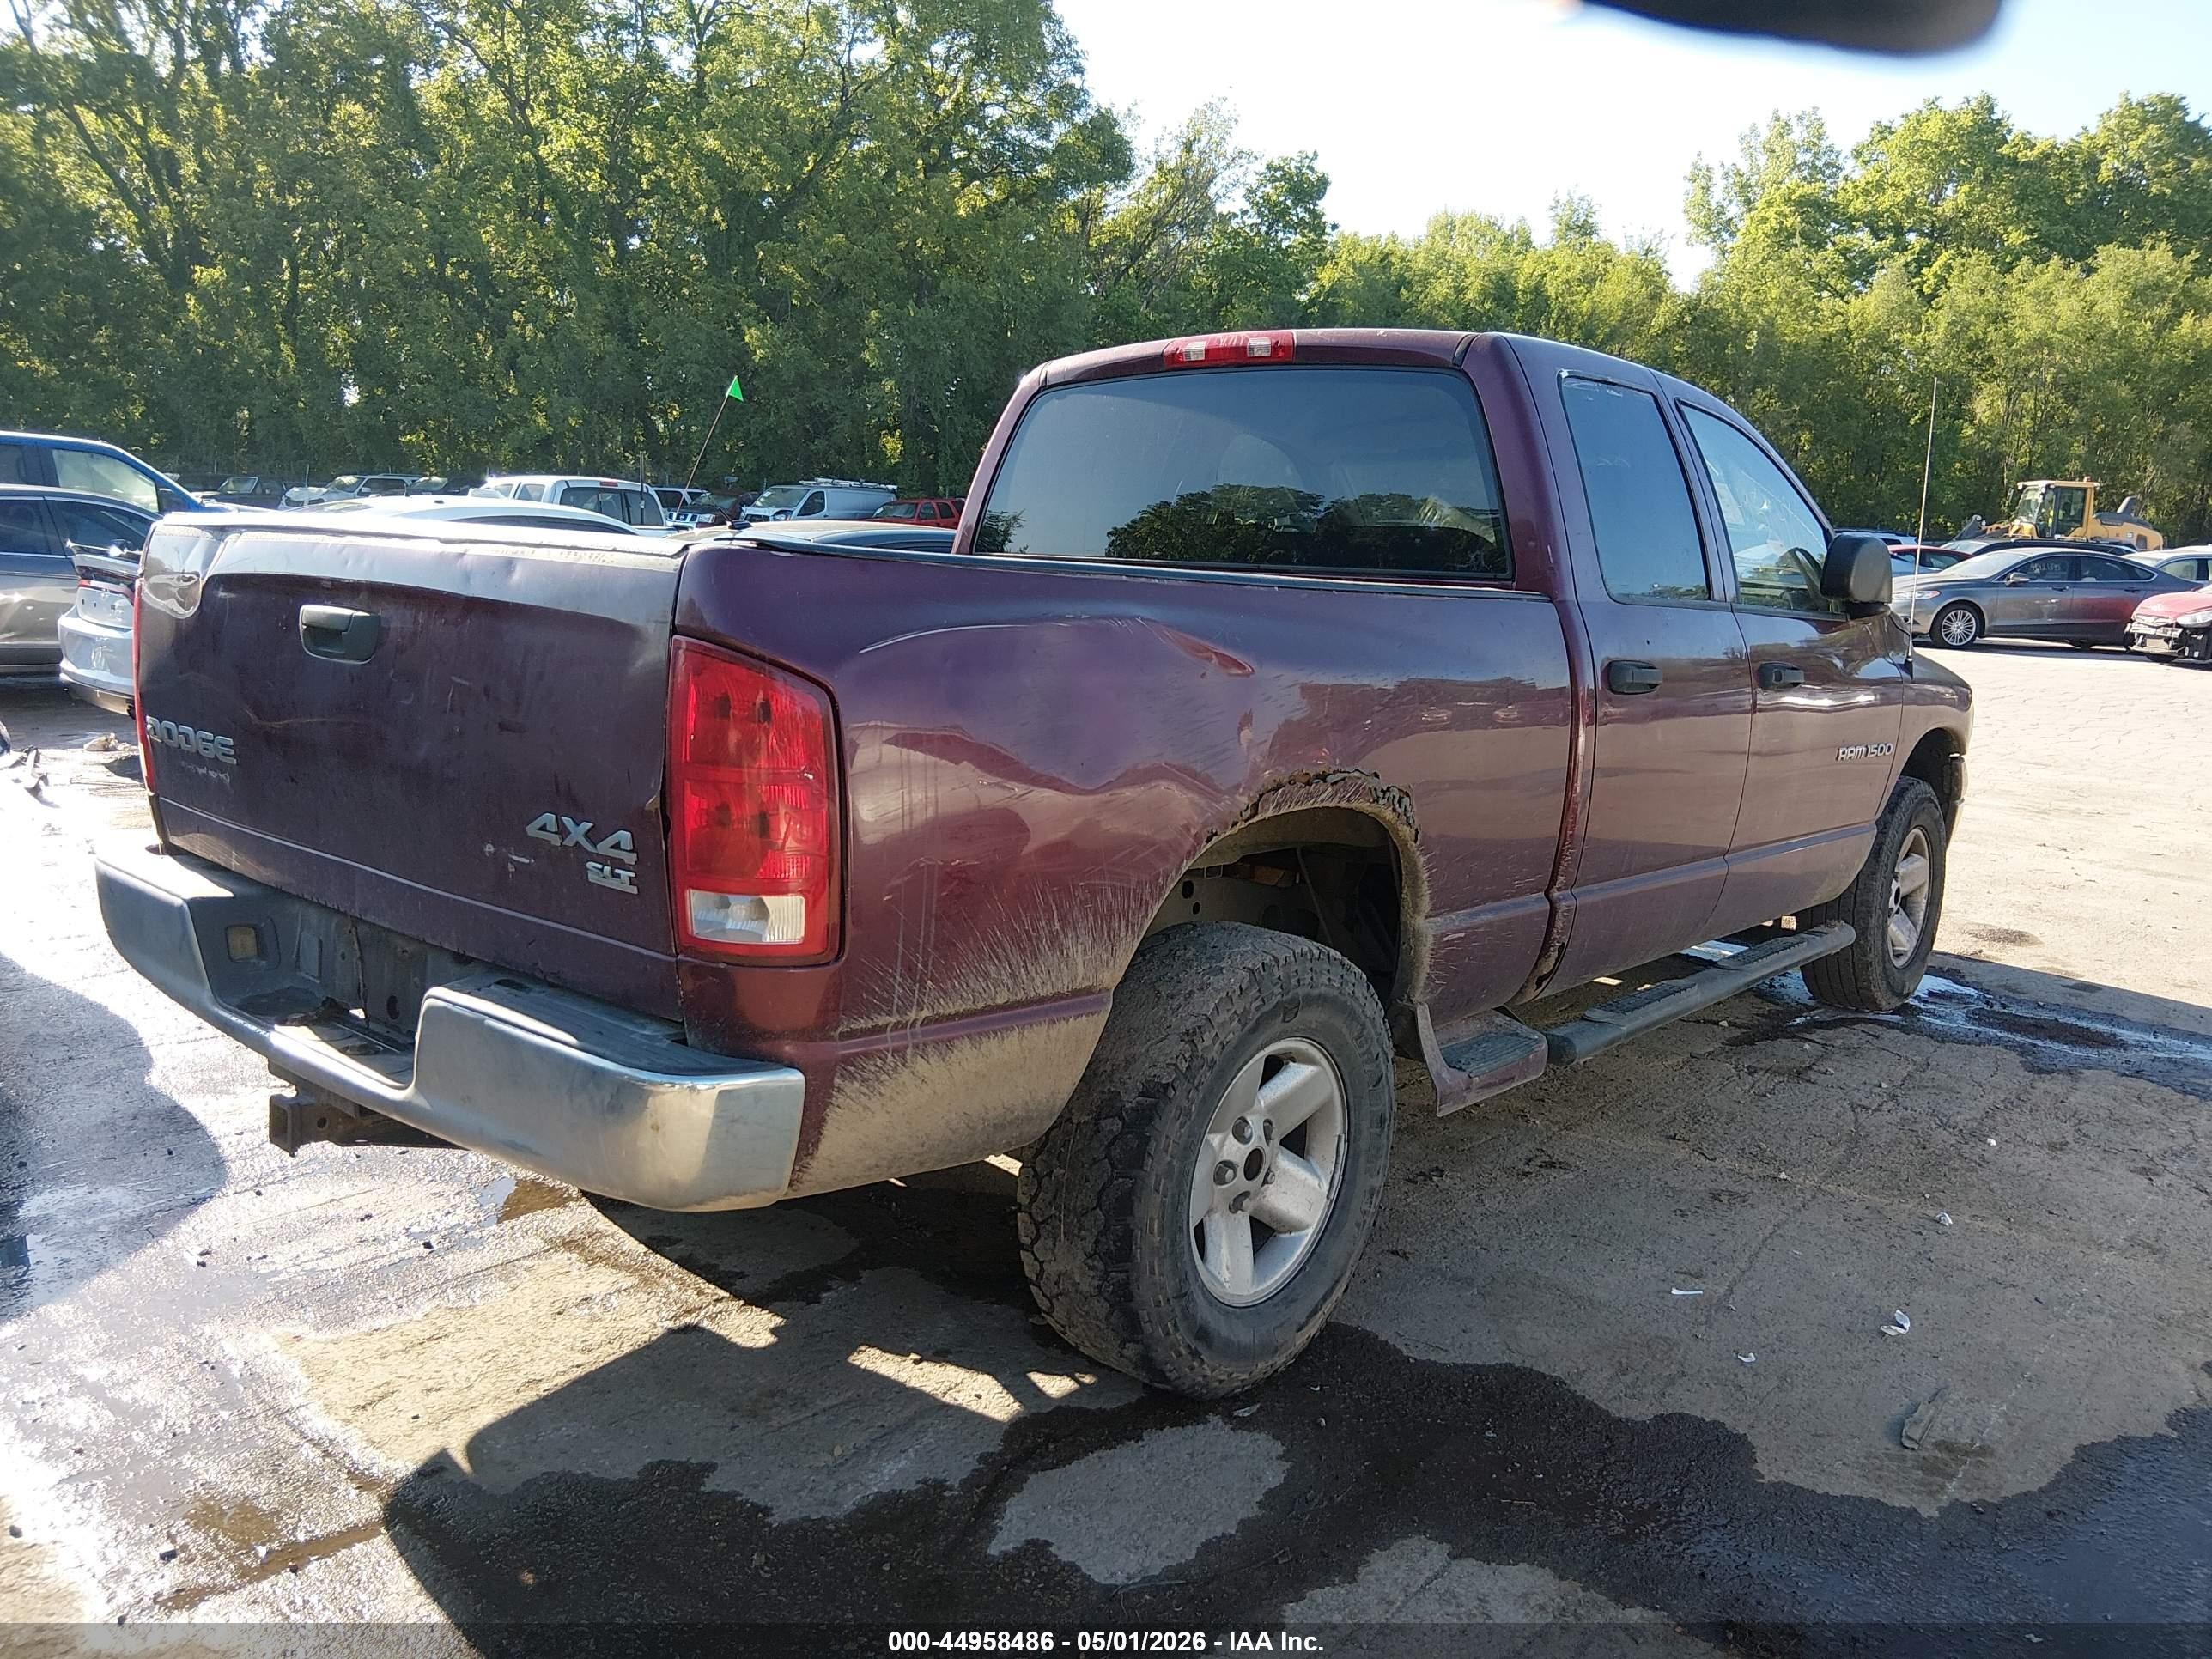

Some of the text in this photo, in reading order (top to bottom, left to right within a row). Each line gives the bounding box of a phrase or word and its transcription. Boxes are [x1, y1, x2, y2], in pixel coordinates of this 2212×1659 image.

[145, 715, 237, 764] DODGE
[526, 812, 637, 865] 4X4
[586, 861, 638, 894] SLT
